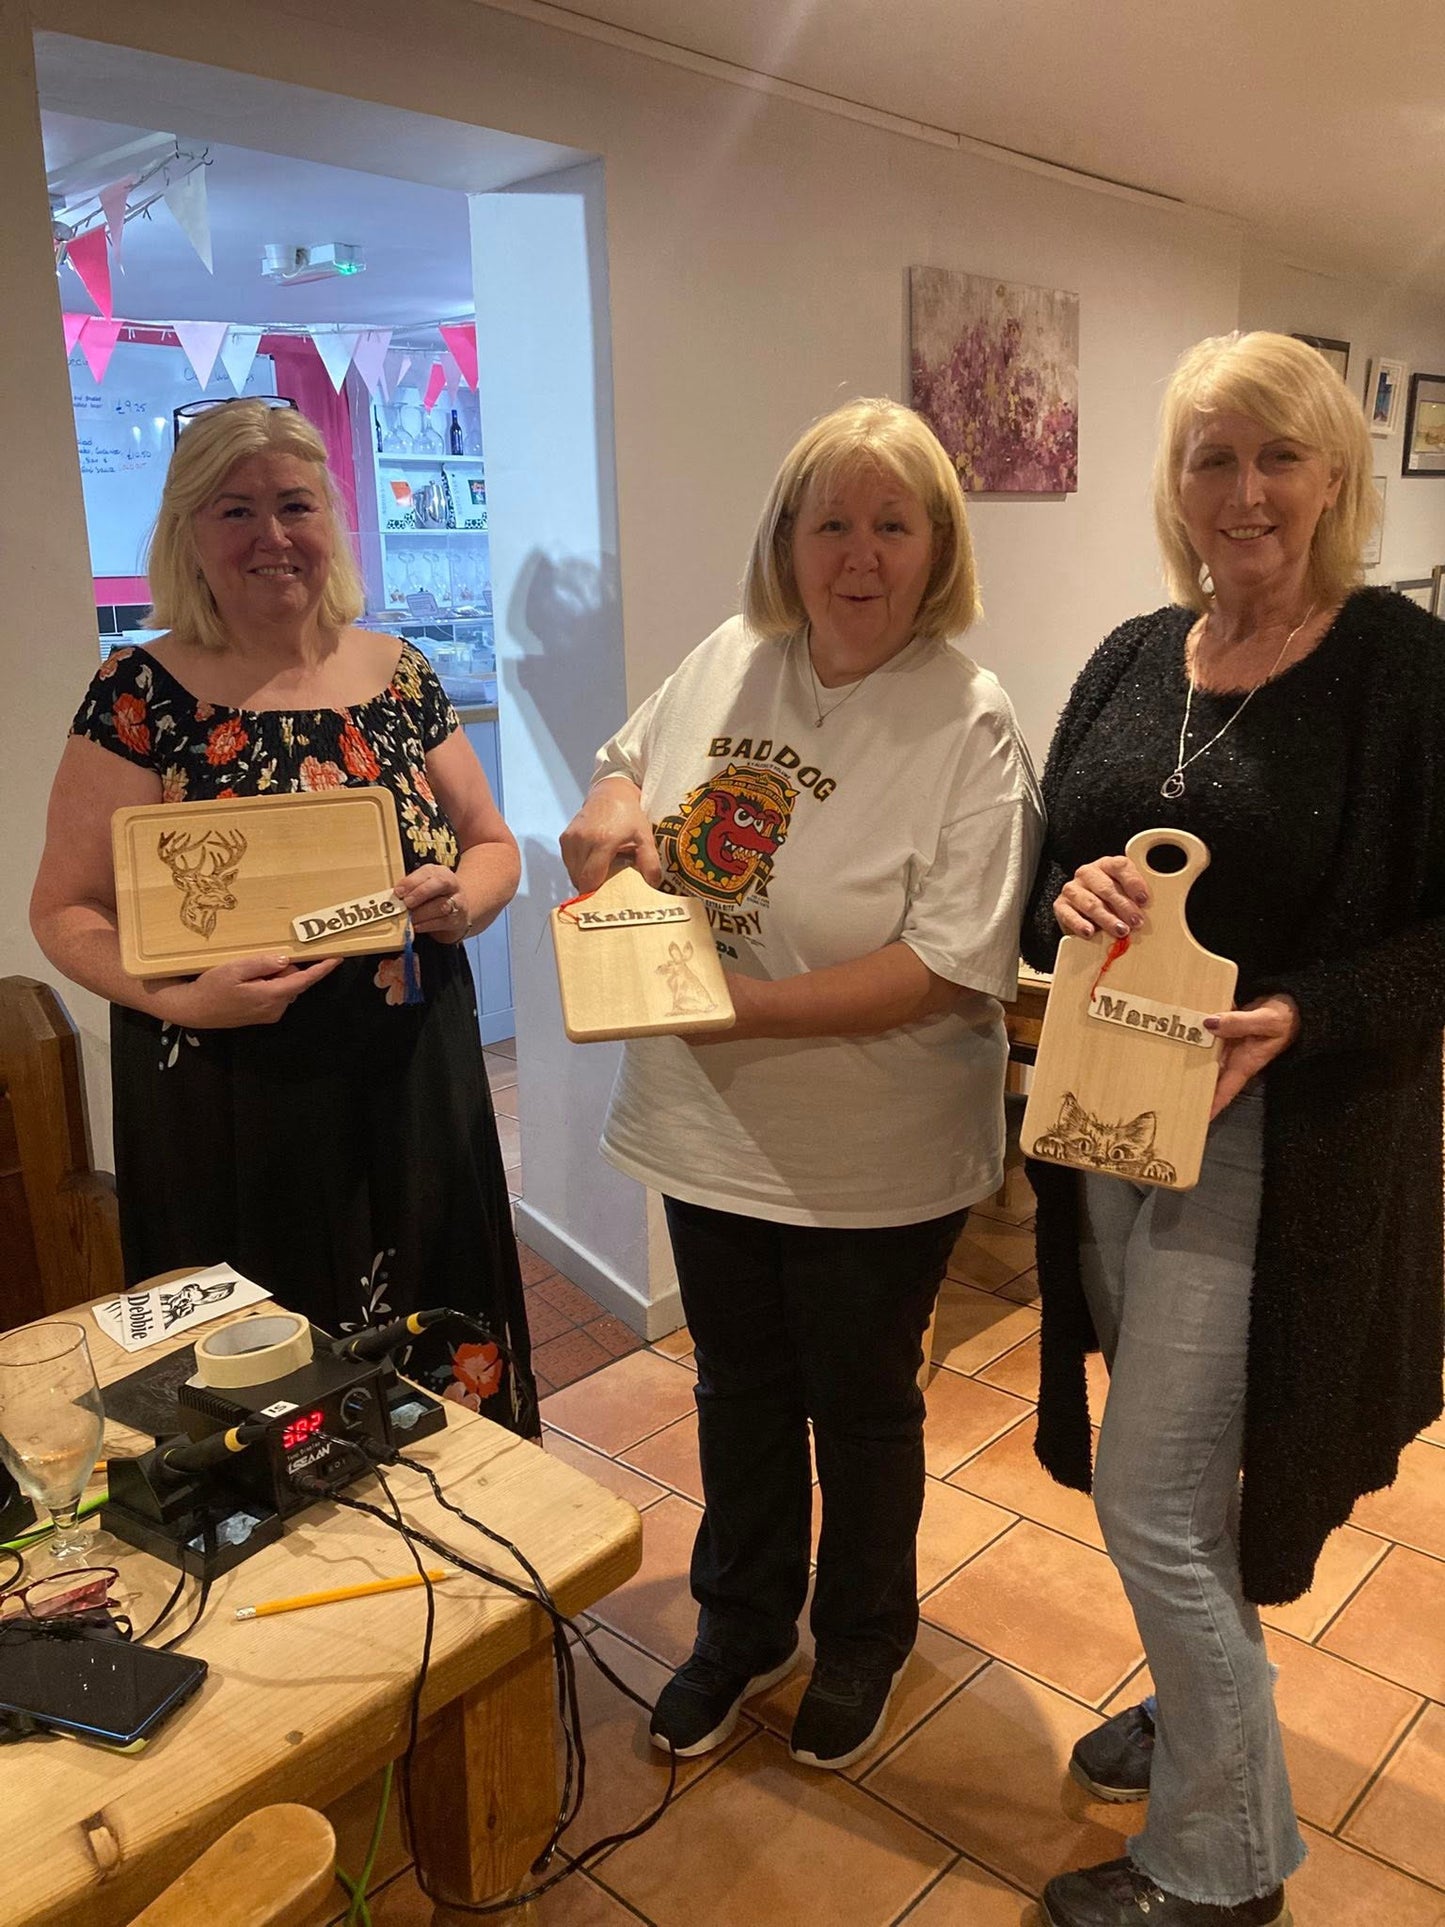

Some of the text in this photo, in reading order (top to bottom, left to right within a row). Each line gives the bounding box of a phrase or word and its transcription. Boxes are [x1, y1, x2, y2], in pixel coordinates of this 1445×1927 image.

[299, 899, 395, 940] Debbie
[580, 905, 685, 924] Kathryn
[1095, 994, 1203, 1043] Marsha
[126, 1292, 154, 1340] Debbie
